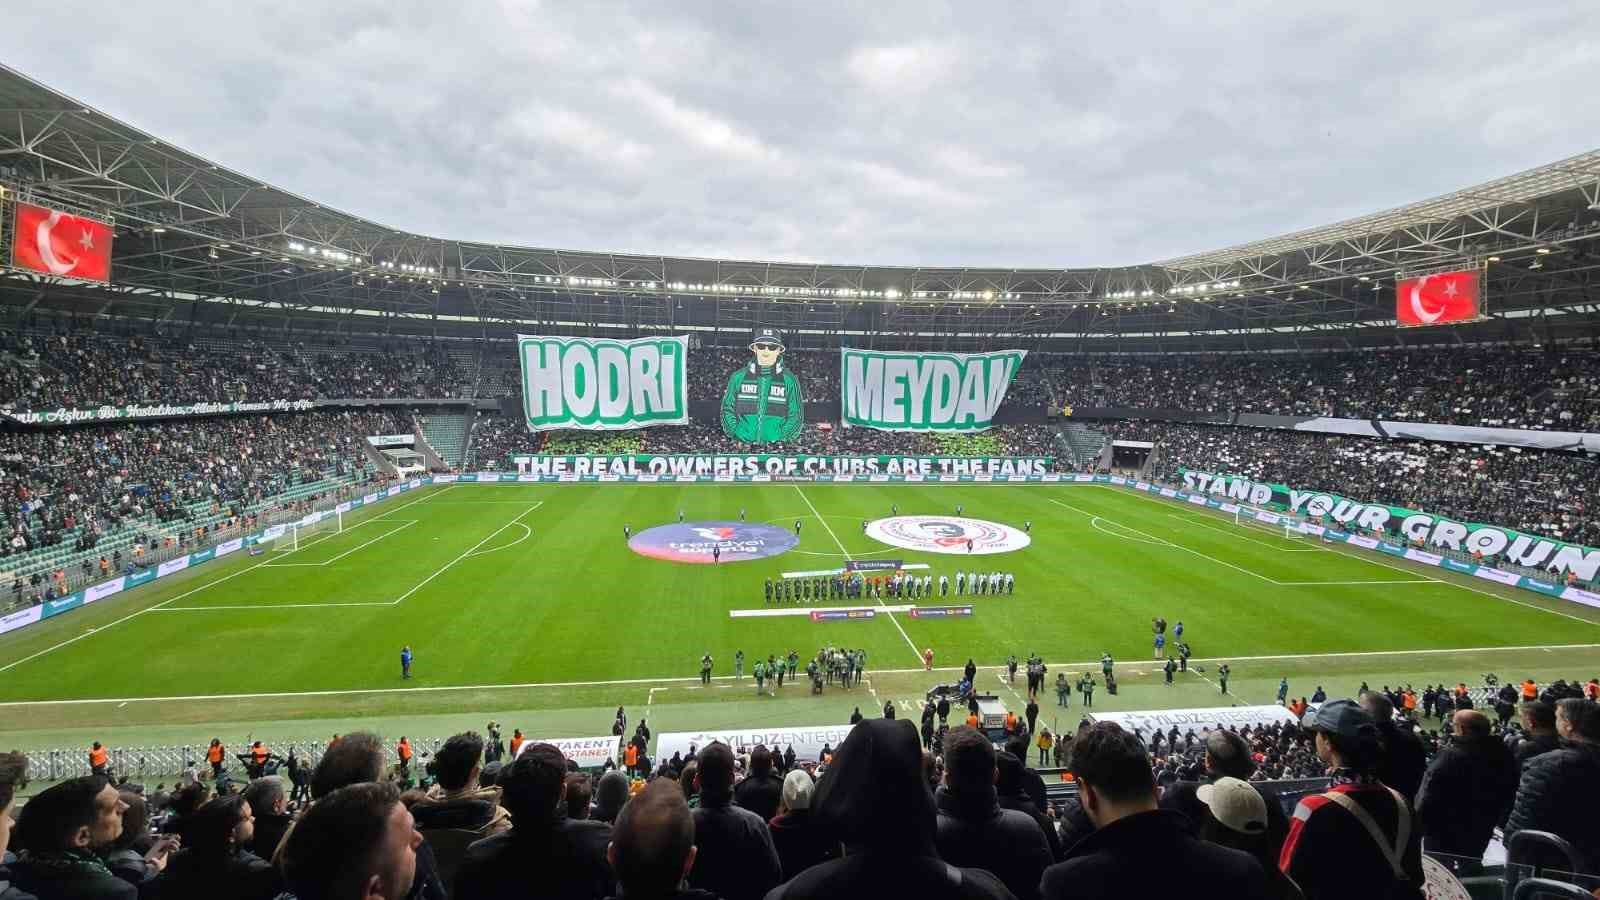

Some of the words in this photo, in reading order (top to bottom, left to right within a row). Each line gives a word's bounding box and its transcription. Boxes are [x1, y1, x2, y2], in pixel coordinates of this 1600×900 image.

[846, 355, 1014, 424] MEYDAN
[97, 405, 122, 419] Bir
[514, 457, 568, 476] THE
[574, 457, 642, 476] REAL
[649, 457, 759, 476] OWNERS
[766, 457, 798, 476] OF
[803, 457, 879, 476] CLUBS
[887, 457, 932, 476] ARE
[938, 457, 986, 476] THE
[987, 457, 1046, 476] FANS
[1182, 471, 1273, 505] STAND
[1287, 490, 1391, 532] YOUR
[668, 539, 765, 549] trendyol
[551, 739, 617, 750] TAKENT
